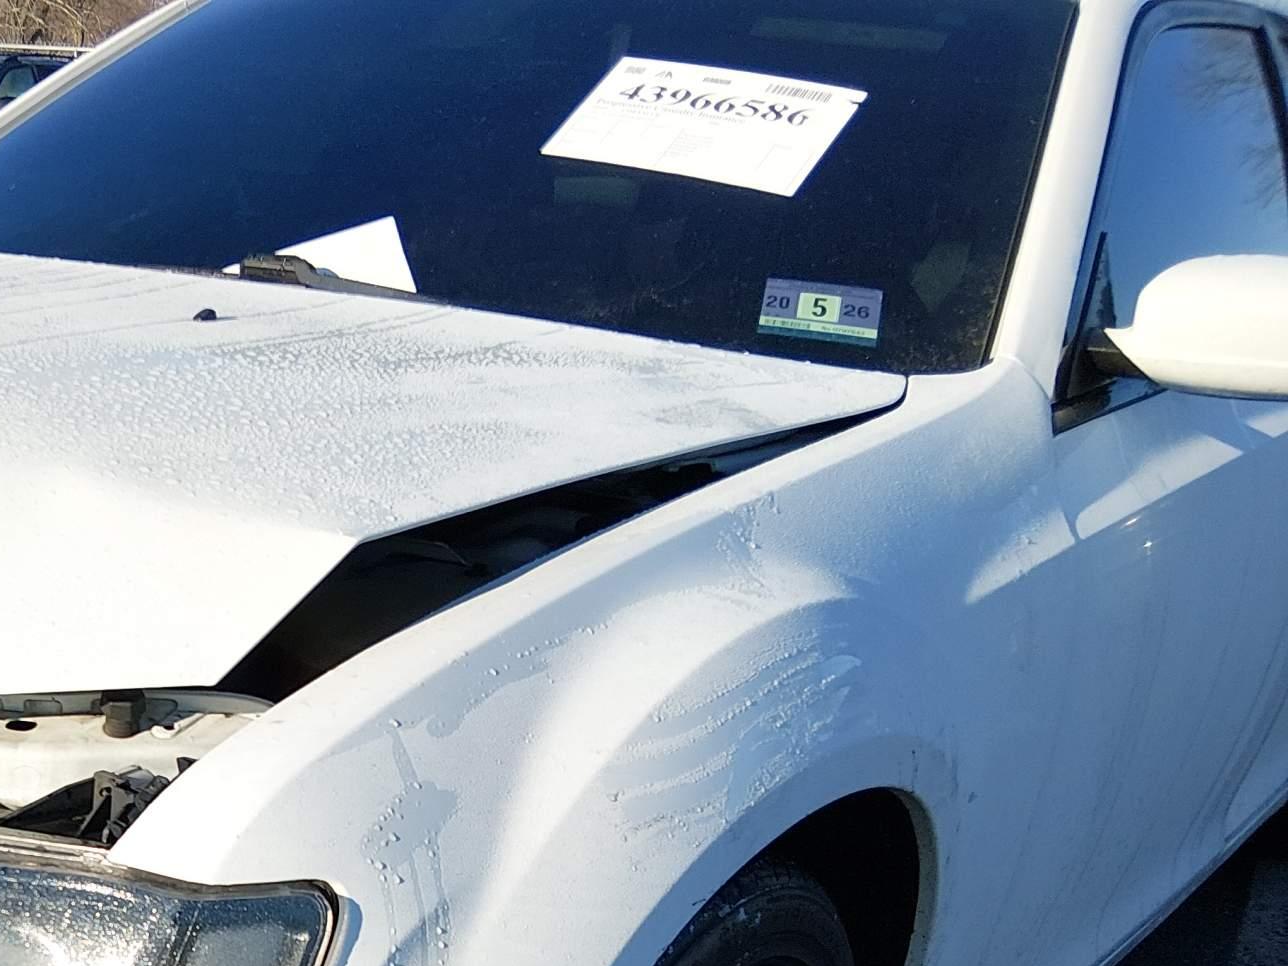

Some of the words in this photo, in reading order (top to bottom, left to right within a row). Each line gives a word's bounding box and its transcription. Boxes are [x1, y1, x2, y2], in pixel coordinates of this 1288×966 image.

[618, 83, 816, 127] 43966586
[765, 295, 790, 310] 20
[811, 297, 828, 318] 5
[843, 304, 870, 319] 26
